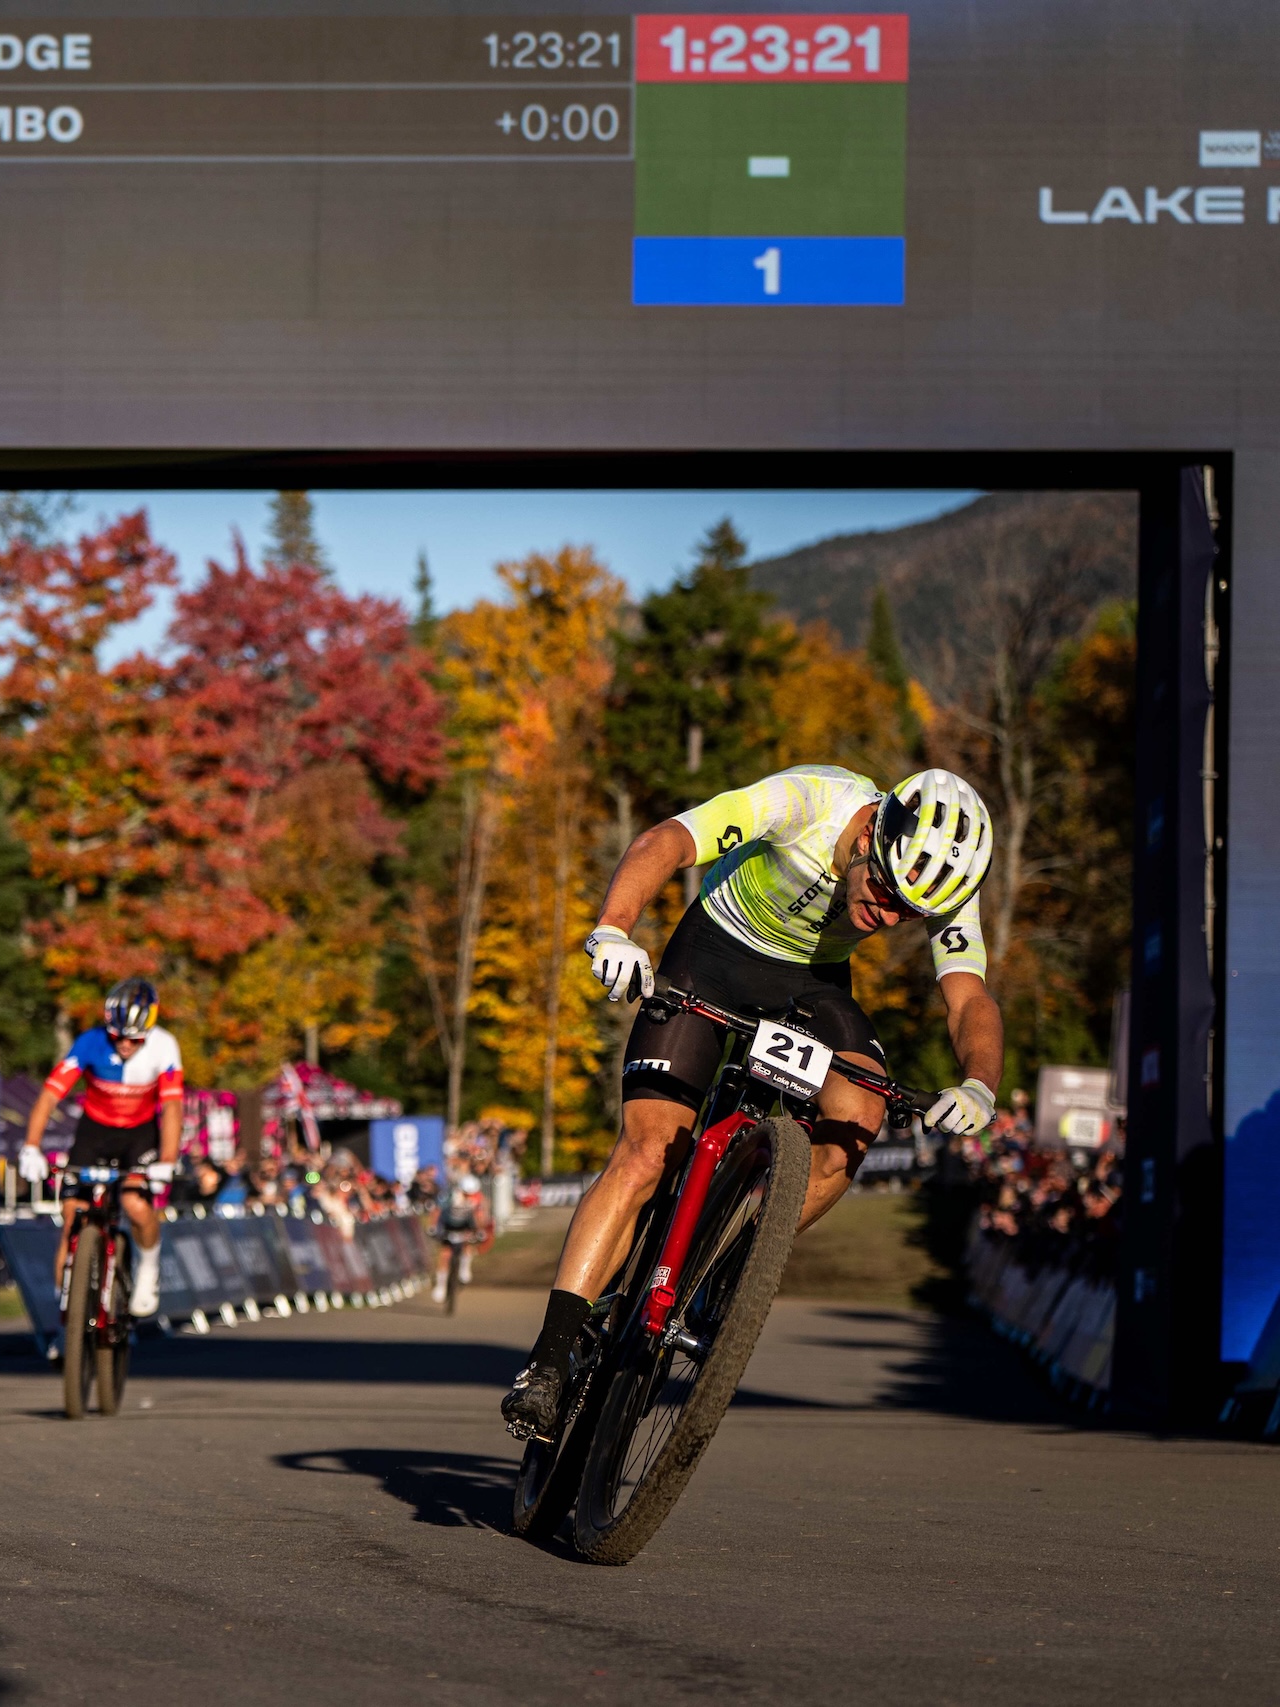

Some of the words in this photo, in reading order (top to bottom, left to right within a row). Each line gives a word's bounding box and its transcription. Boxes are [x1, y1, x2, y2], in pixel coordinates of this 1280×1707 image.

[483, 32, 622, 69] 1:23:21
[659, 25, 882, 74] 1:23:21
[495, 104, 620, 141] +0:00
[1037, 186, 1245, 224] LAKE
[752, 247, 783, 296] 1
[787, 871, 837, 915] SCOTT
[623, 1058, 672, 1073] AM
[765, 1032, 814, 1071] 21
[773, 1073, 790, 1086] Lake
[790, 1081, 812, 1096] Placid
